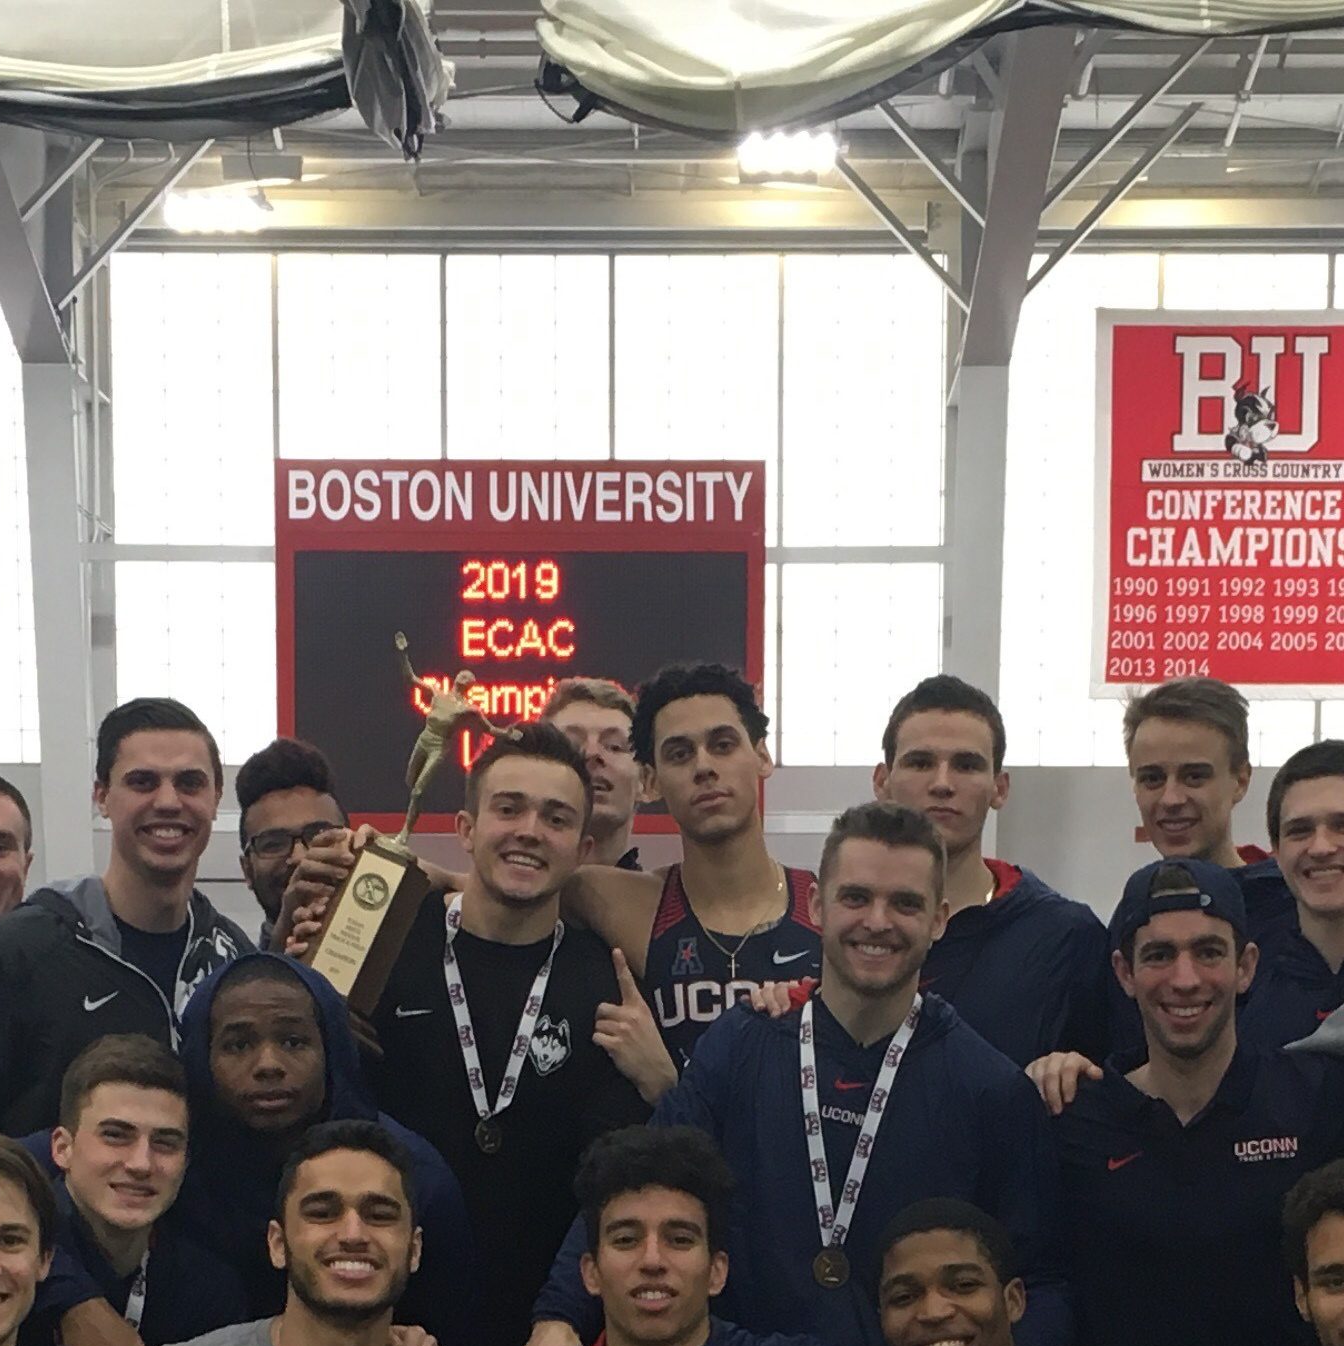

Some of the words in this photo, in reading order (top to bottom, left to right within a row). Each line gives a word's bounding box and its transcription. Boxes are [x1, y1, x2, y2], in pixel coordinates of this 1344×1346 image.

[1173, 333, 1330, 453] BU
[1149, 463, 1219, 478] WOMEN'S
[1223, 463, 1268, 478] CROSS
[1272, 463, 1343, 478] COUNTRY
[288, 470, 473, 521] BOSTON
[490, 471, 753, 521] UNIVERSITY
[1146, 490, 1342, 521] CONFERENCE
[462, 562, 558, 600] 2019
[1113, 577, 1158, 597] 1990
[1165, 577, 1210, 597] 1991
[1219, 577, 1264, 597] 1992
[1273, 577, 1318, 597] 1993
[1113, 605, 1157, 624] 1996
[1165, 605, 1209, 624] 1997
[1219, 605, 1264, 624] 1998
[1272, 605, 1318, 624] 1999
[462, 619, 576, 658] ECAC
[1111, 631, 1155, 650] 2001
[1163, 631, 1209, 650] 2002
[1217, 631, 1263, 650] 2004
[1271, 631, 1317, 650] 2005
[1110, 658, 1155, 677] 2013
[1163, 658, 1210, 679] 2014
[1234, 1136, 1298, 1156] UCONN
